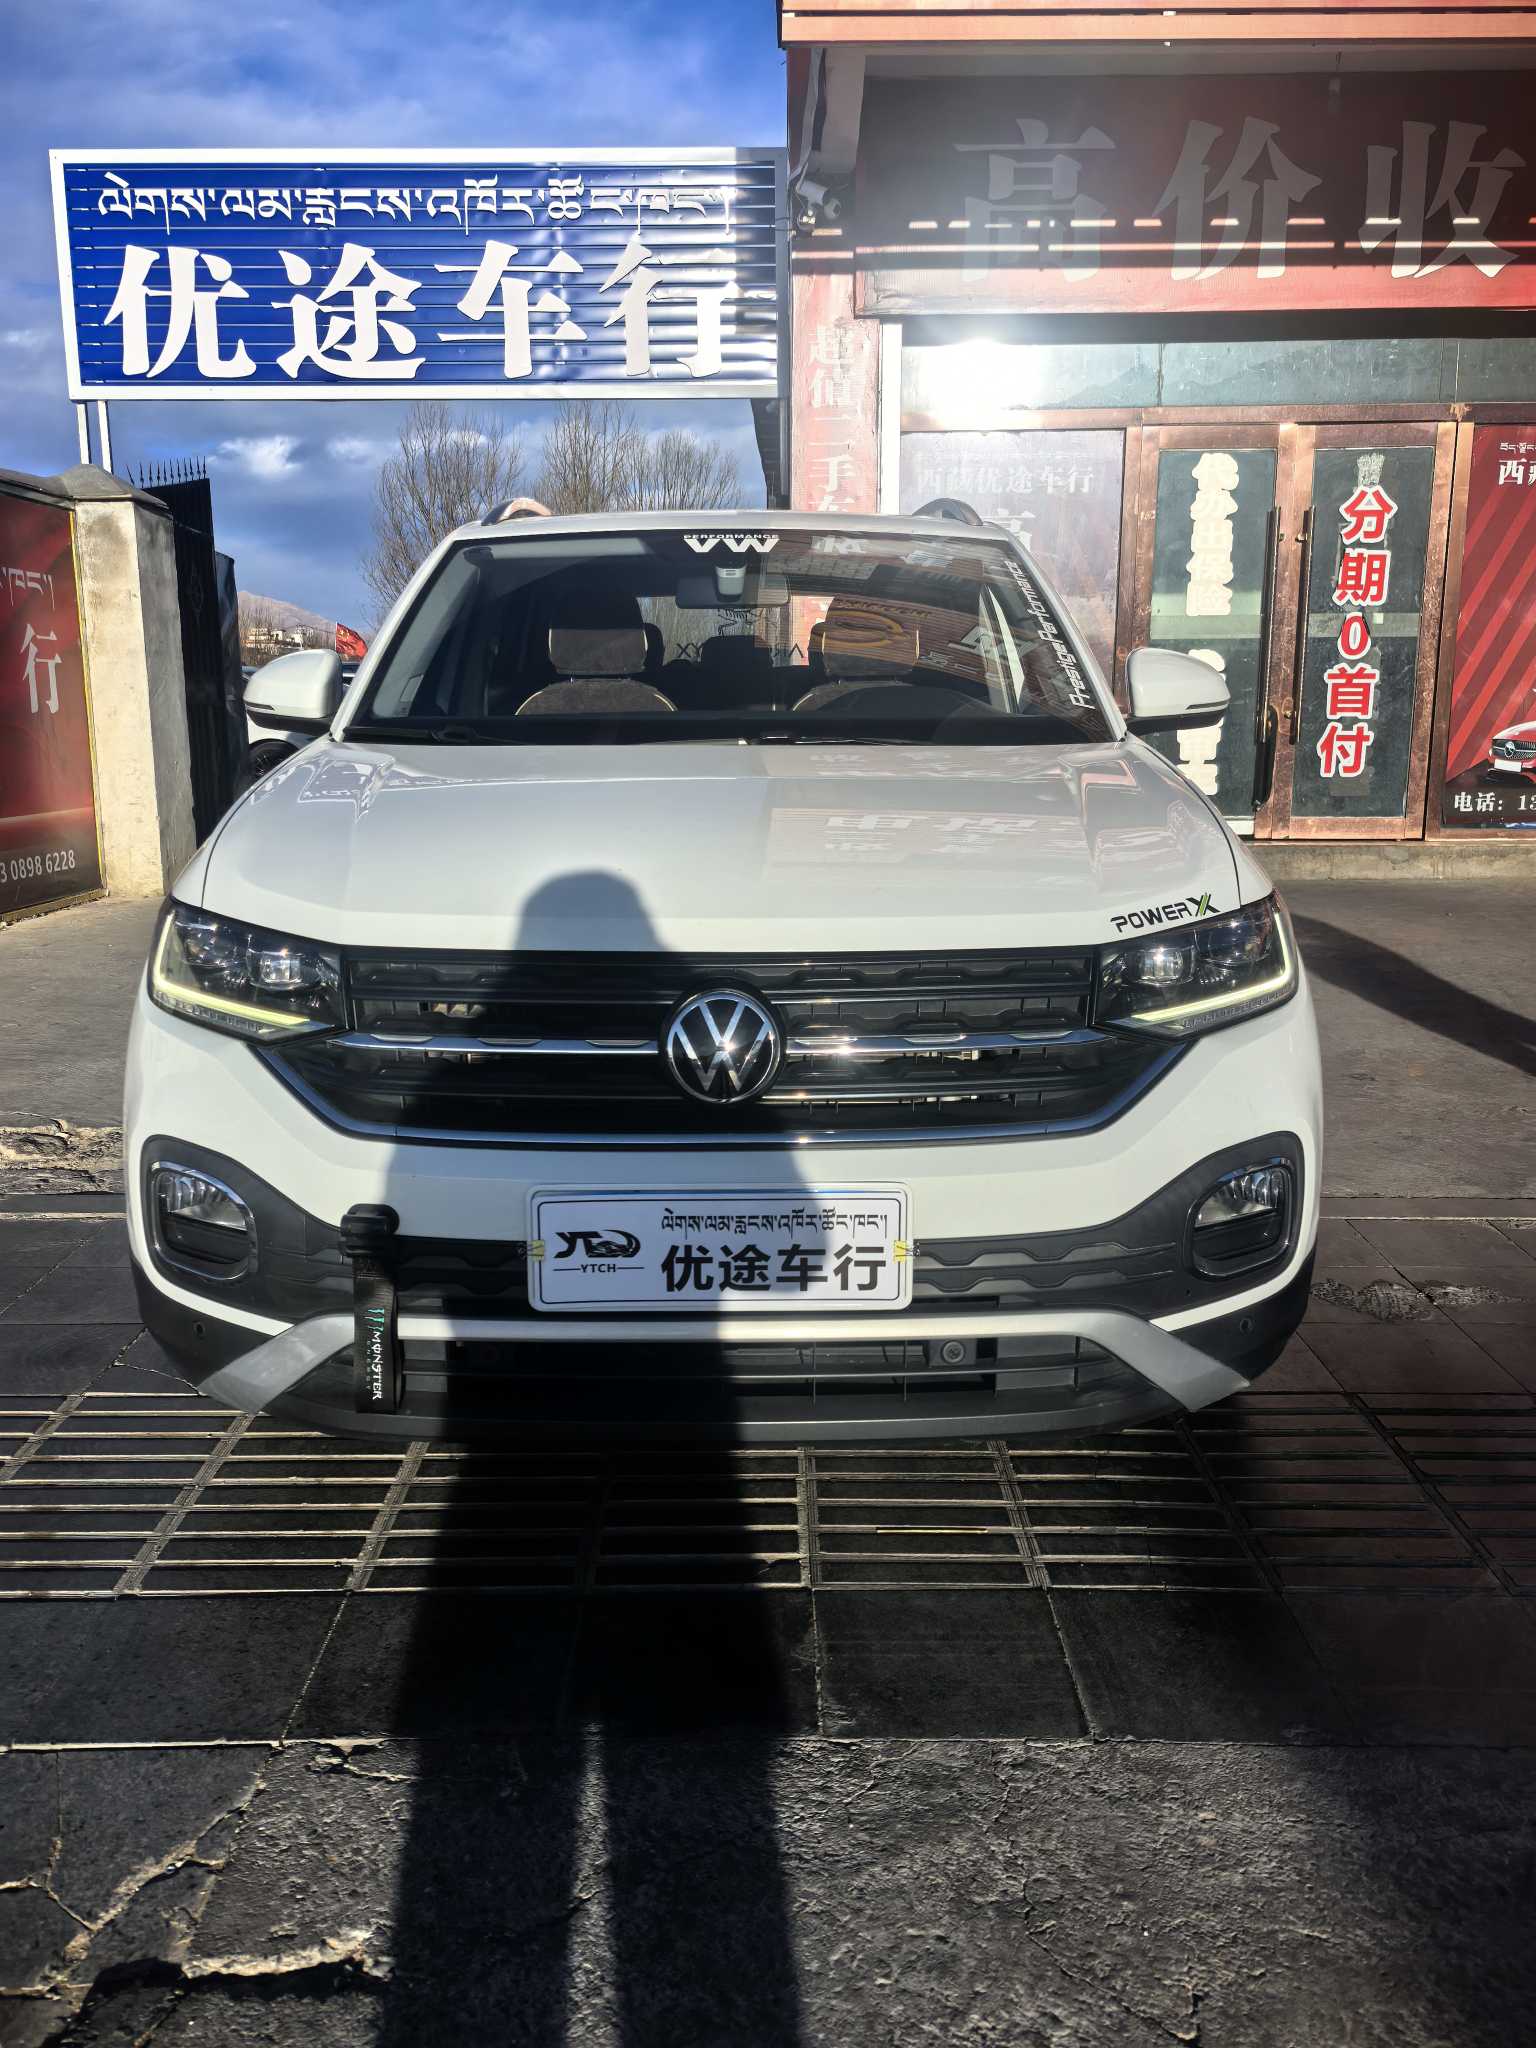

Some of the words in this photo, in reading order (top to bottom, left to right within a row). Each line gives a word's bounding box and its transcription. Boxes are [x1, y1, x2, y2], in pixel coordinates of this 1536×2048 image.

[952, 116, 1526, 281] 高价收
[103, 240, 738, 379] 优途车行
[20, 623, 63, 714] 行
[10, 855, 42, 881] 0898
[45, 849, 76, 873] 6228
[580, 1263, 616, 1273] YTCH
[661, 1243, 887, 1292] 优途车行
[371, 1331, 383, 1400] MONSTER
